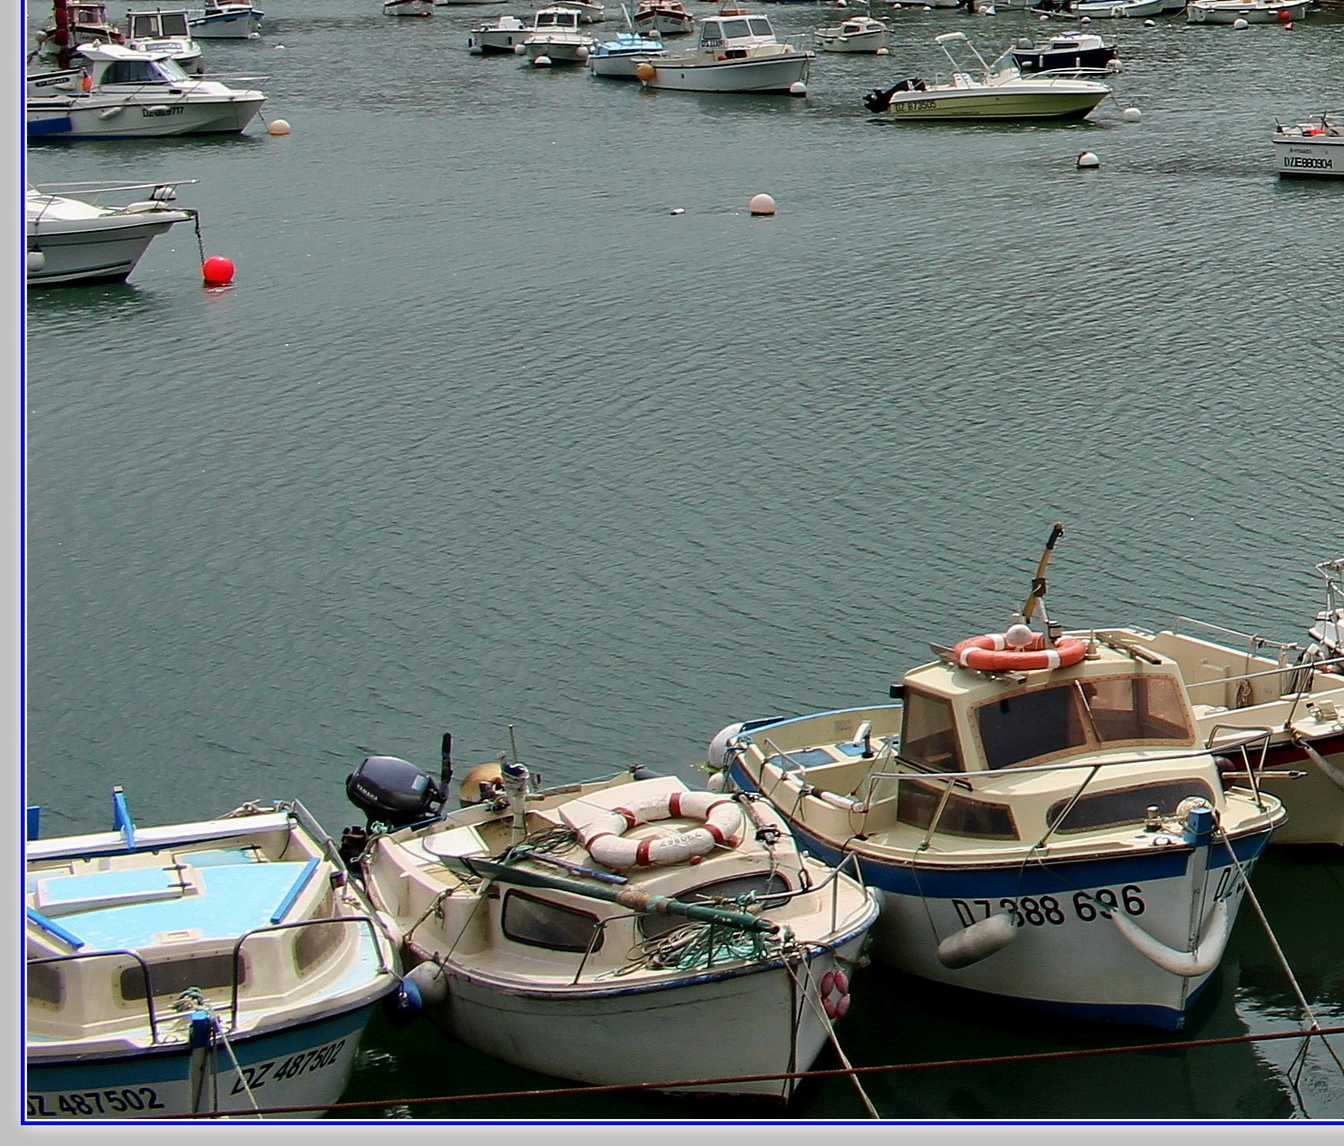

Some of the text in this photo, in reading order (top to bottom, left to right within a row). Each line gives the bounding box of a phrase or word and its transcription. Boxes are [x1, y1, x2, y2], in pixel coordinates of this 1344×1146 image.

[356, 784, 378, 801] YAMAHA
[1000, 895, 1065, 928] 388
[1072, 884, 1146, 922] 696
[229, 1039, 346, 1096] DZ 487502
[58, 1087, 166, 1116] 487502
